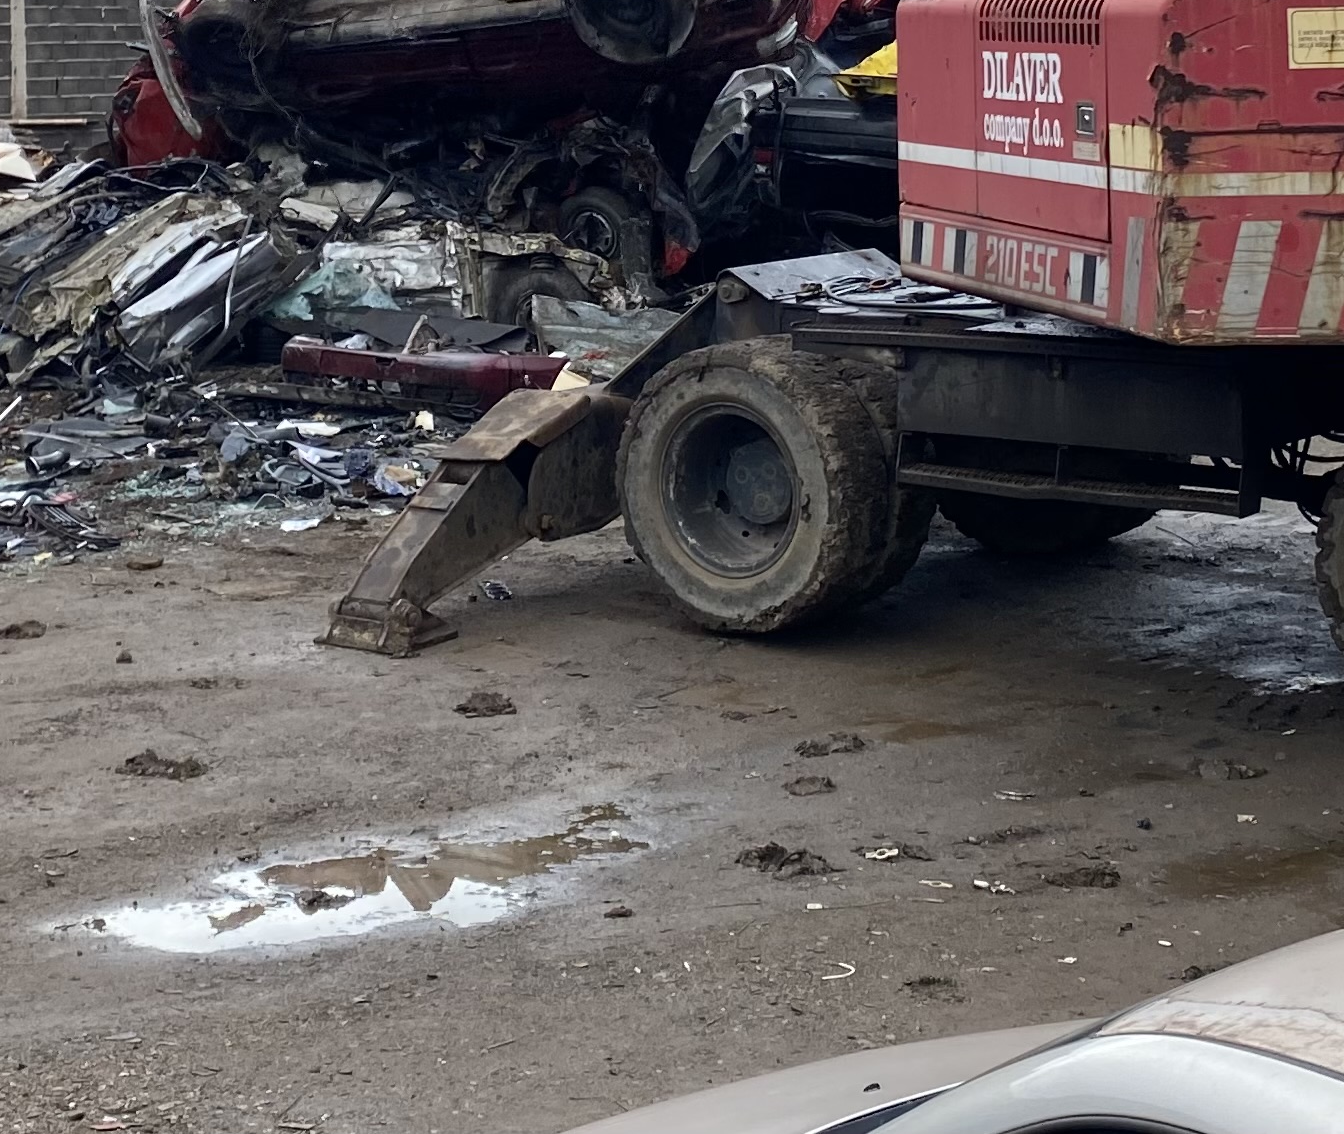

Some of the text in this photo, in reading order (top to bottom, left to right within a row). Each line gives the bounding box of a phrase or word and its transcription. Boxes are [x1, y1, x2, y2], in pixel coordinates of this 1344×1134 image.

[982, 51, 1064, 104] DILAVER
[983, 113, 1030, 156] company
[1032, 107, 1064, 148] d.o.o.
[984, 235, 1017, 287] 210
